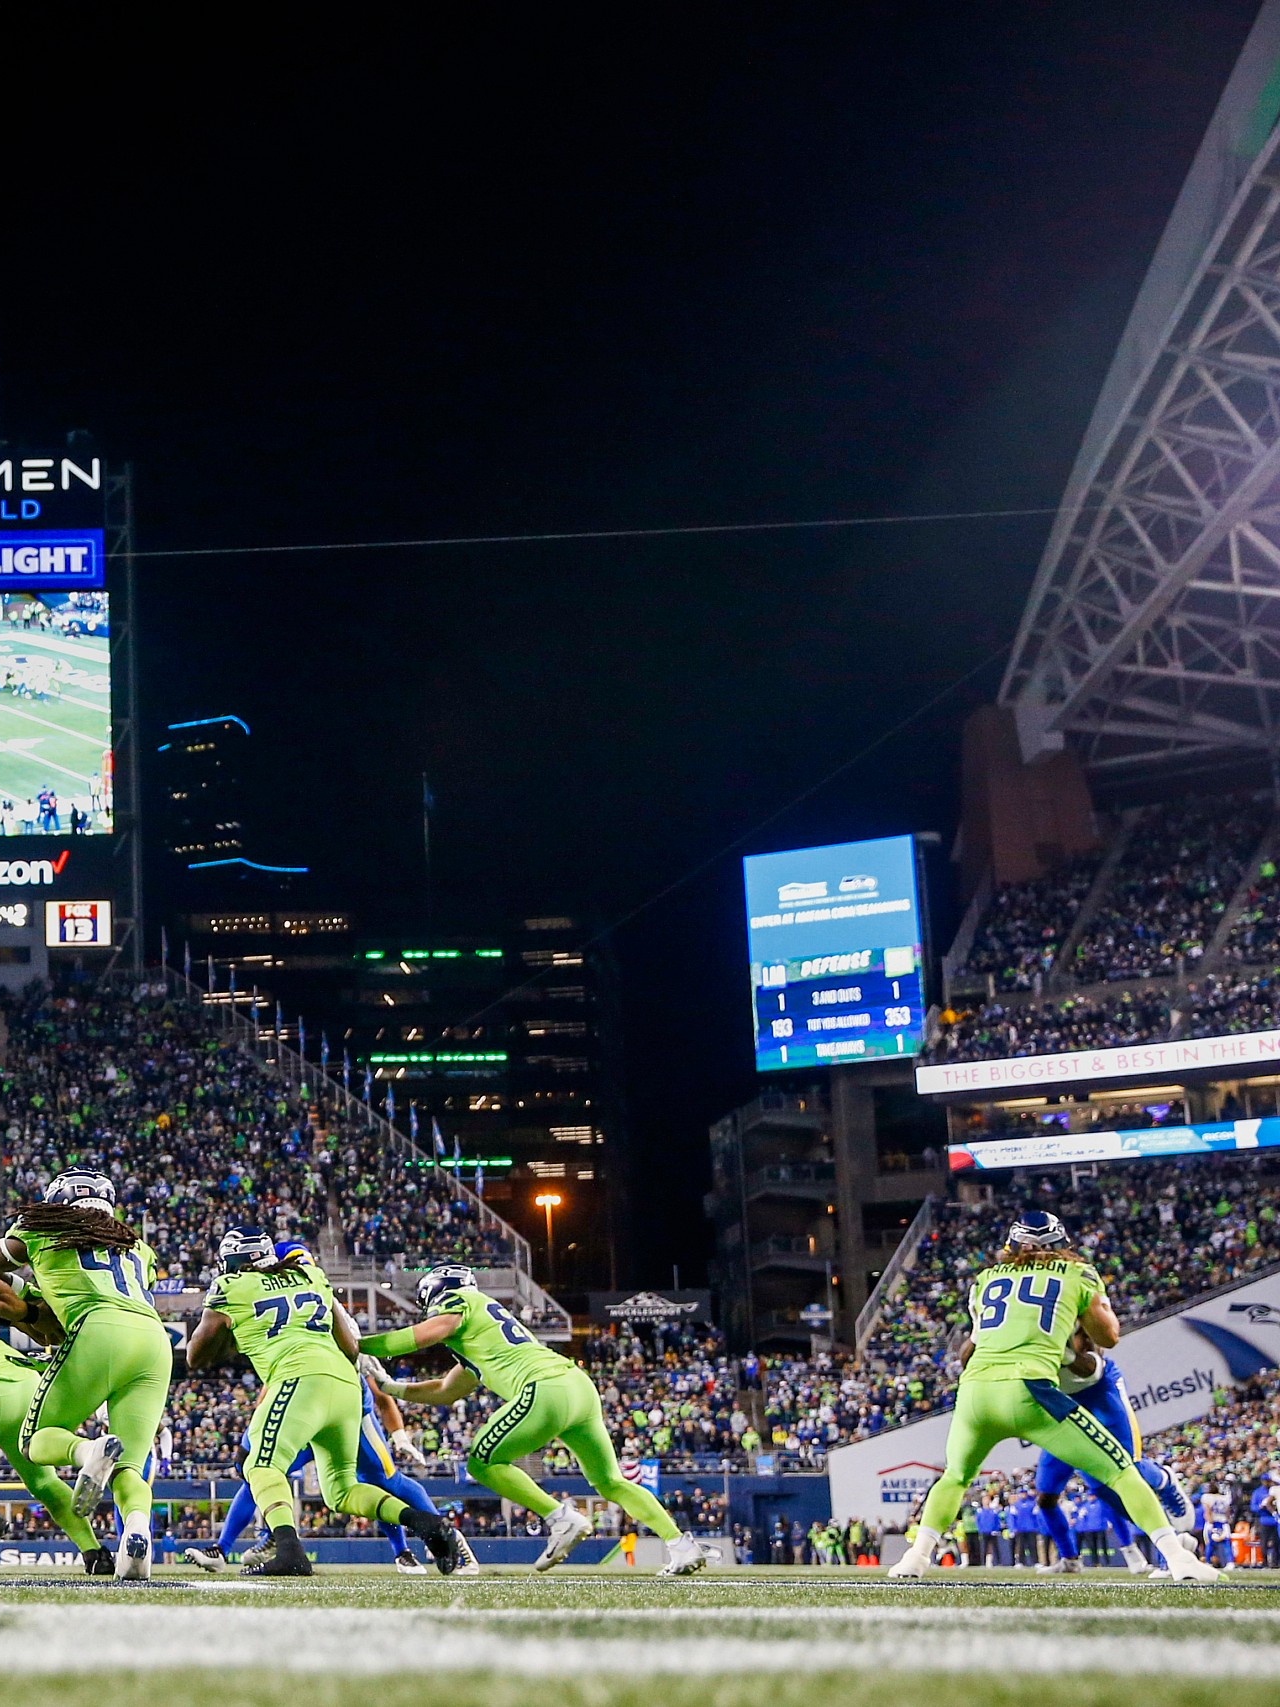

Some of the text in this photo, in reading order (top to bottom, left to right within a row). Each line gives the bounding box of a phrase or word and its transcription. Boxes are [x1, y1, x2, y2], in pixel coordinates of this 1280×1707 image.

[64, 904, 92, 918] FOX
[63, 918, 94, 942] 13
[800, 949, 872, 977] DEFENSE
[777, 992, 785, 1011] 1
[891, 981, 900, 1000] 1
[884, 1006, 911, 1027] 353
[780, 1045, 788, 1064] 1
[895, 1034, 904, 1053] 1
[943, 1038, 1280, 1085] THE BIGGEST & BEST IN THE N
[76, 1245, 155, 1308] 41
[253, 1291, 331, 1340] 72
[609, 1306, 681, 1317] MUCKLESHOOT
[979, 1275, 1063, 1335] 84
[1128, 1367, 1214, 1412] arlessly
[881, 1478, 932, 1489] AMERIC
[0, 1549, 85, 1567] SEAHA
